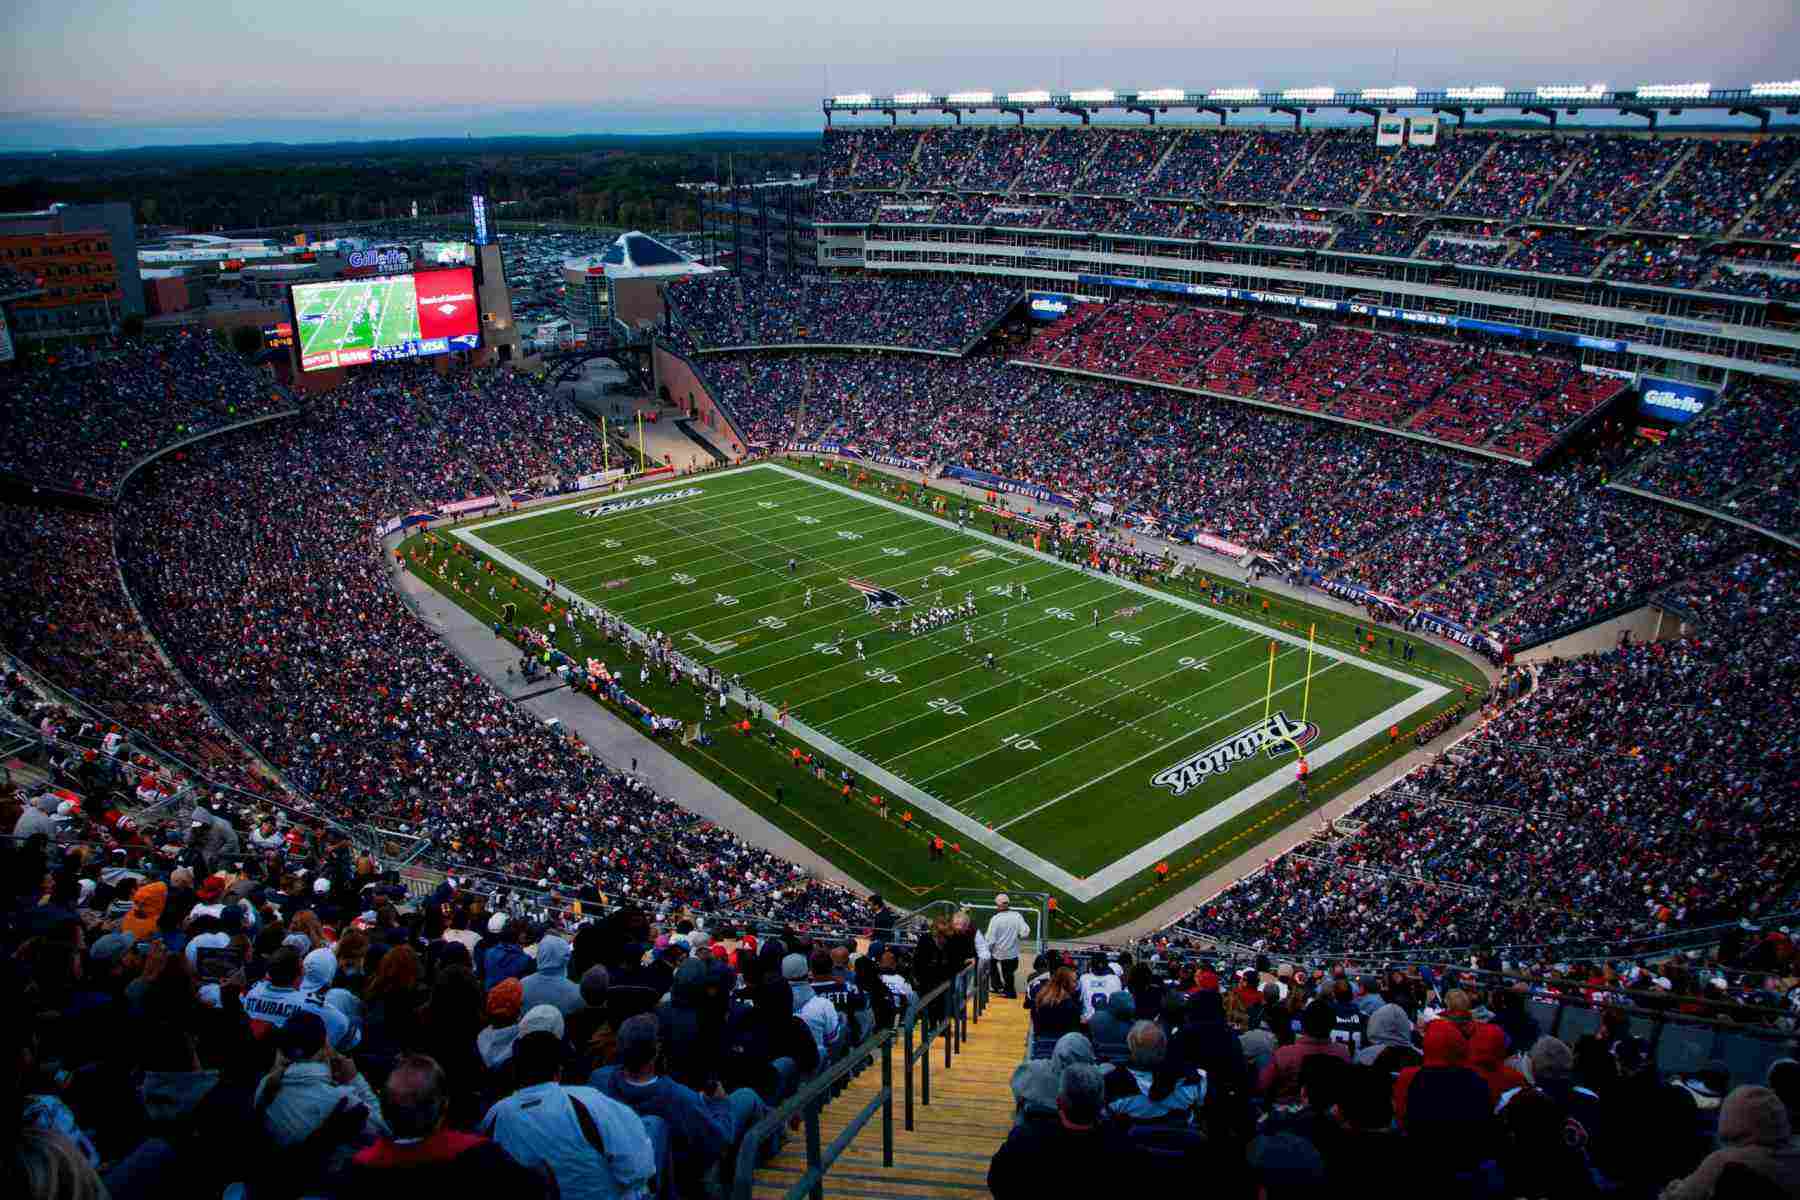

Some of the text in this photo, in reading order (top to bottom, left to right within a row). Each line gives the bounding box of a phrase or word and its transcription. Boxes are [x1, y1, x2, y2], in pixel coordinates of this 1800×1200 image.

[348, 248, 409, 267] Gillette
[1031, 299, 1068, 312] Gillette
[1644, 389, 1704, 414] Gillette
[865, 667, 897, 683] 30
[927, 697, 962, 715] 20
[1000, 733, 1036, 750] 10
[1150, 710, 1320, 796] Patriots
